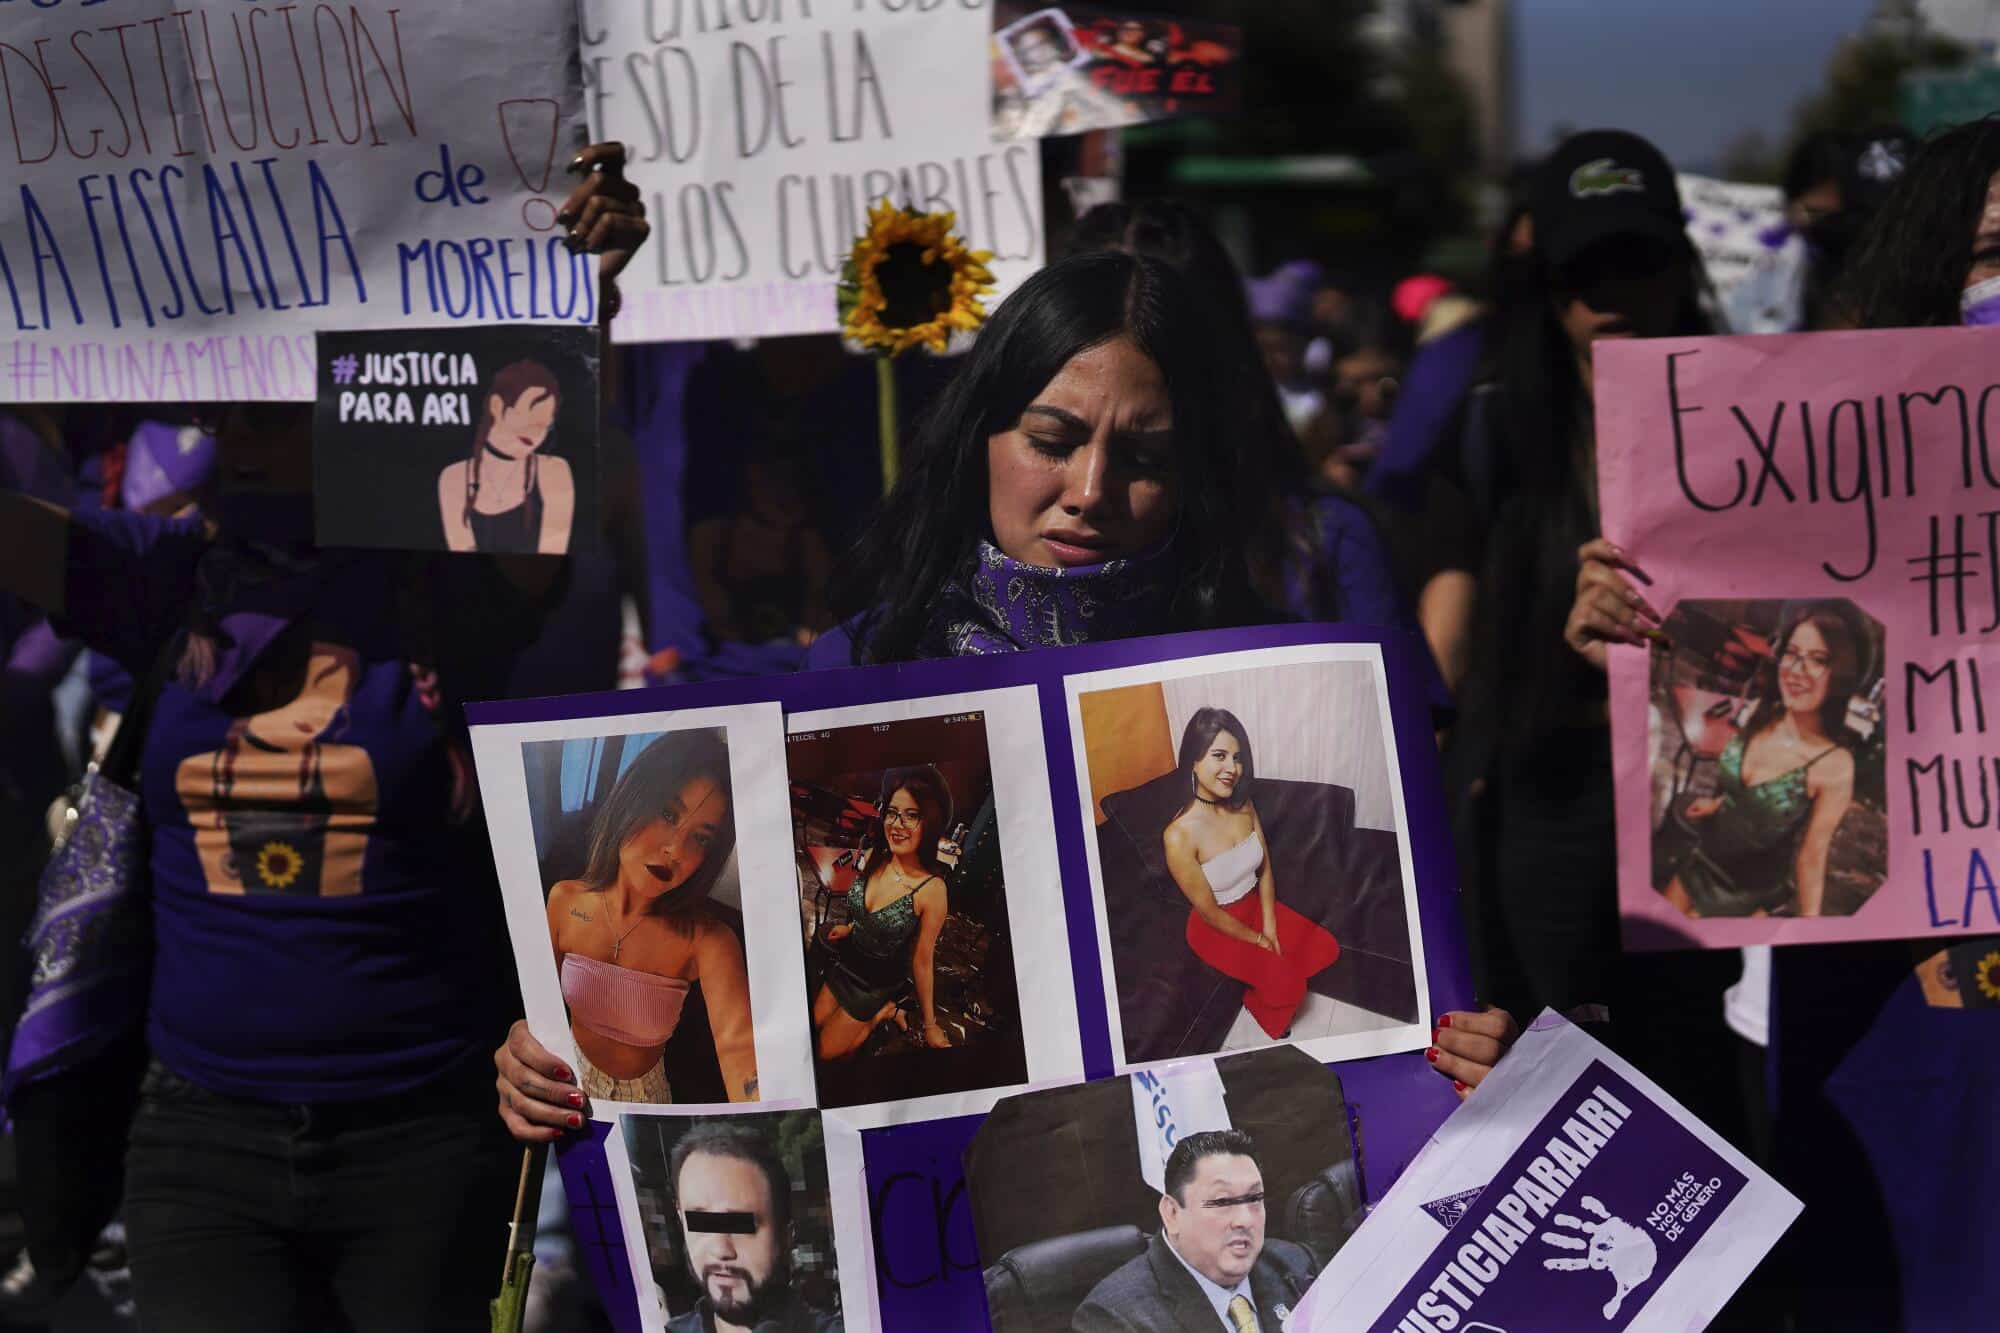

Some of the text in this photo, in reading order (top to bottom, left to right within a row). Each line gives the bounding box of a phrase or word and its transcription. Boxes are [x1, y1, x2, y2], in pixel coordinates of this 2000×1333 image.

[730, 35, 804, 158] DE
[821, 29, 893, 142] LA
[79, 158, 367, 328] FISCALIA
[414, 143, 490, 207] de
[654, 180, 750, 286] LOS
[331, 352, 478, 386] #JUSTICIA
[339, 392, 471, 425] PARA ARI
[1904, 657, 1988, 734] MI
[1906, 754, 2000, 836] MU
[1391, 1085, 1634, 1333] USTICIAPARAARI
[1645, 1171, 1695, 1227] NO MÁS
[1656, 1182, 1703, 1232] VIOLENCIA
[1665, 1221, 1686, 1242] DE
